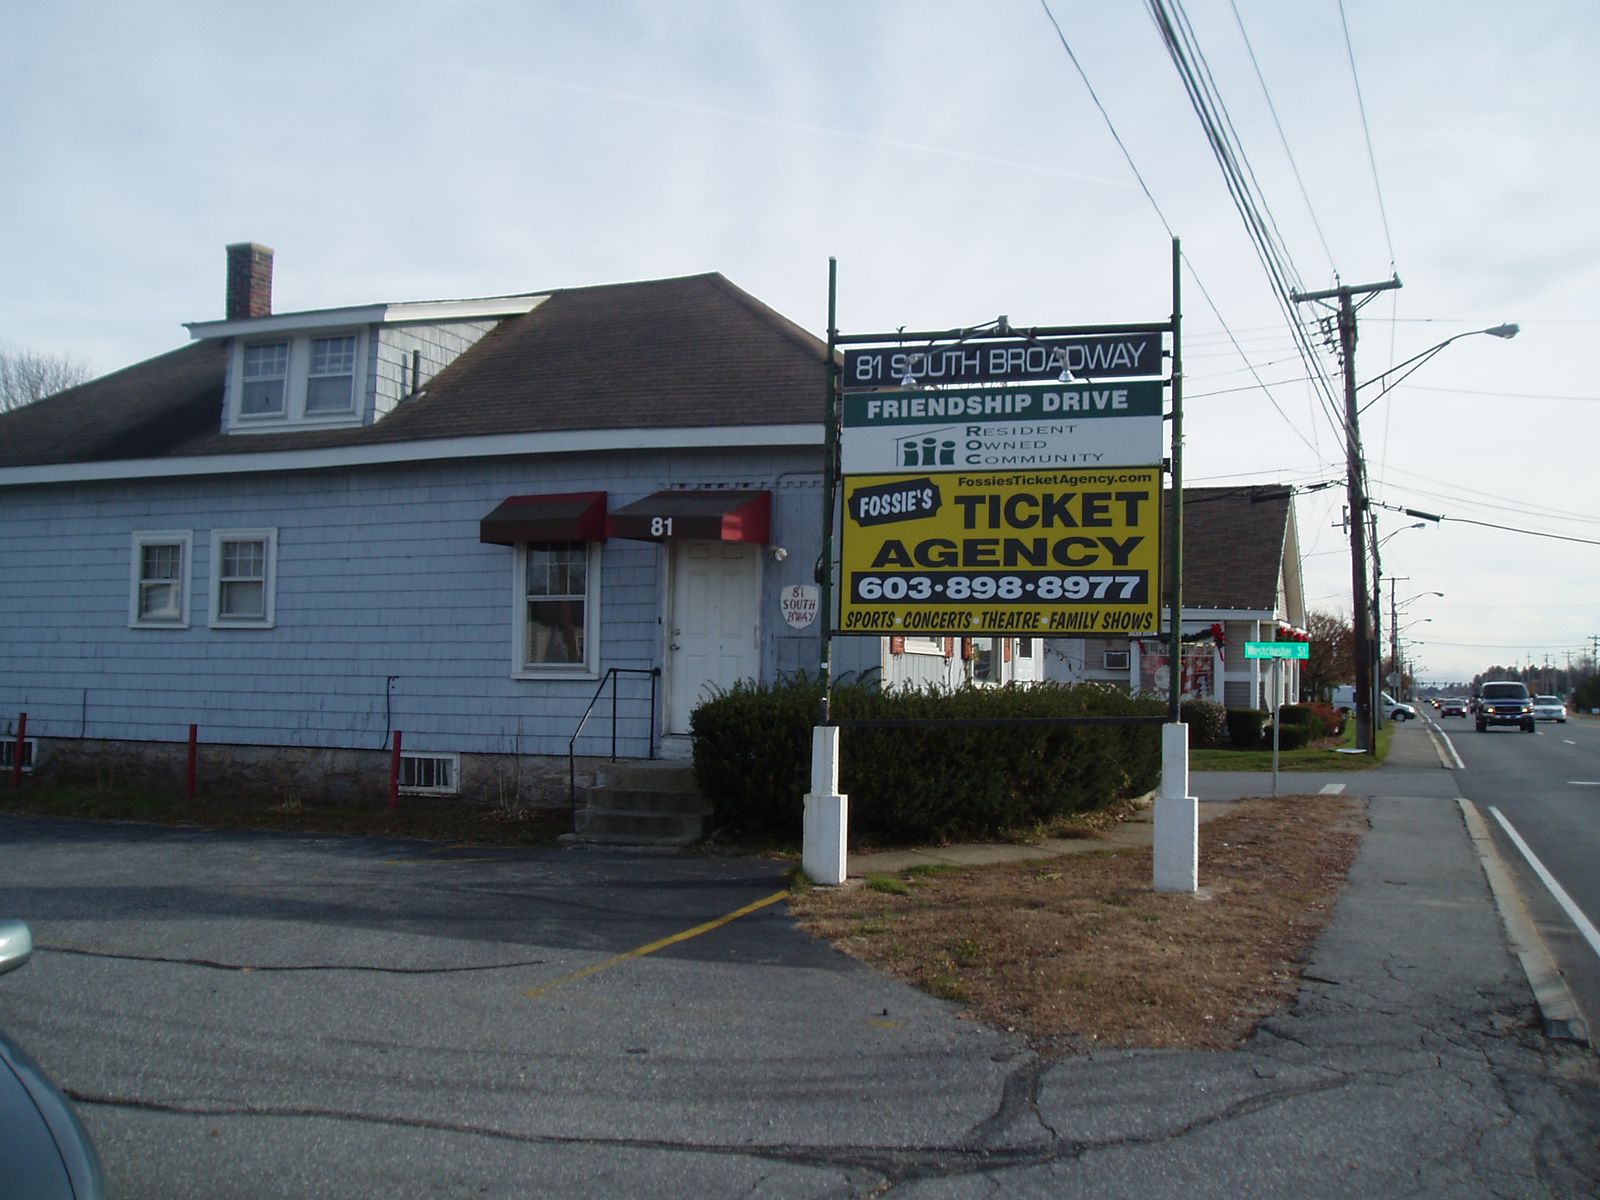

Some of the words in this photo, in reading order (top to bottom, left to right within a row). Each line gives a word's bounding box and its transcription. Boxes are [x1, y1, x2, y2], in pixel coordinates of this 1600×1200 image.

[856, 355, 883, 380] 81
[891, 350, 980, 378] SOUTH
[989, 342, 1147, 374] BROADWAY
[867, 393, 1032, 419] FRIENDSHIP
[1042, 390, 1129, 412] DRIVE
[958, 474, 1152, 488] FossiesTicketAgency.com
[859, 488, 934, 518] FOSSIE'S
[954, 491, 1149, 529] TICKET
[651, 517, 673, 536] 81
[870, 536, 1146, 568] AGENCY
[792, 586, 804, 598] 81
[783, 599, 816, 610] SOUTH
[845, 611, 895, 629] SPORTS
[903, 611, 972, 629] CONCERTS
[981, 611, 1041, 629] THEATRE
[1049, 611, 1101, 629] FAMILY
[1102, 611, 1152, 629] SHOWS
